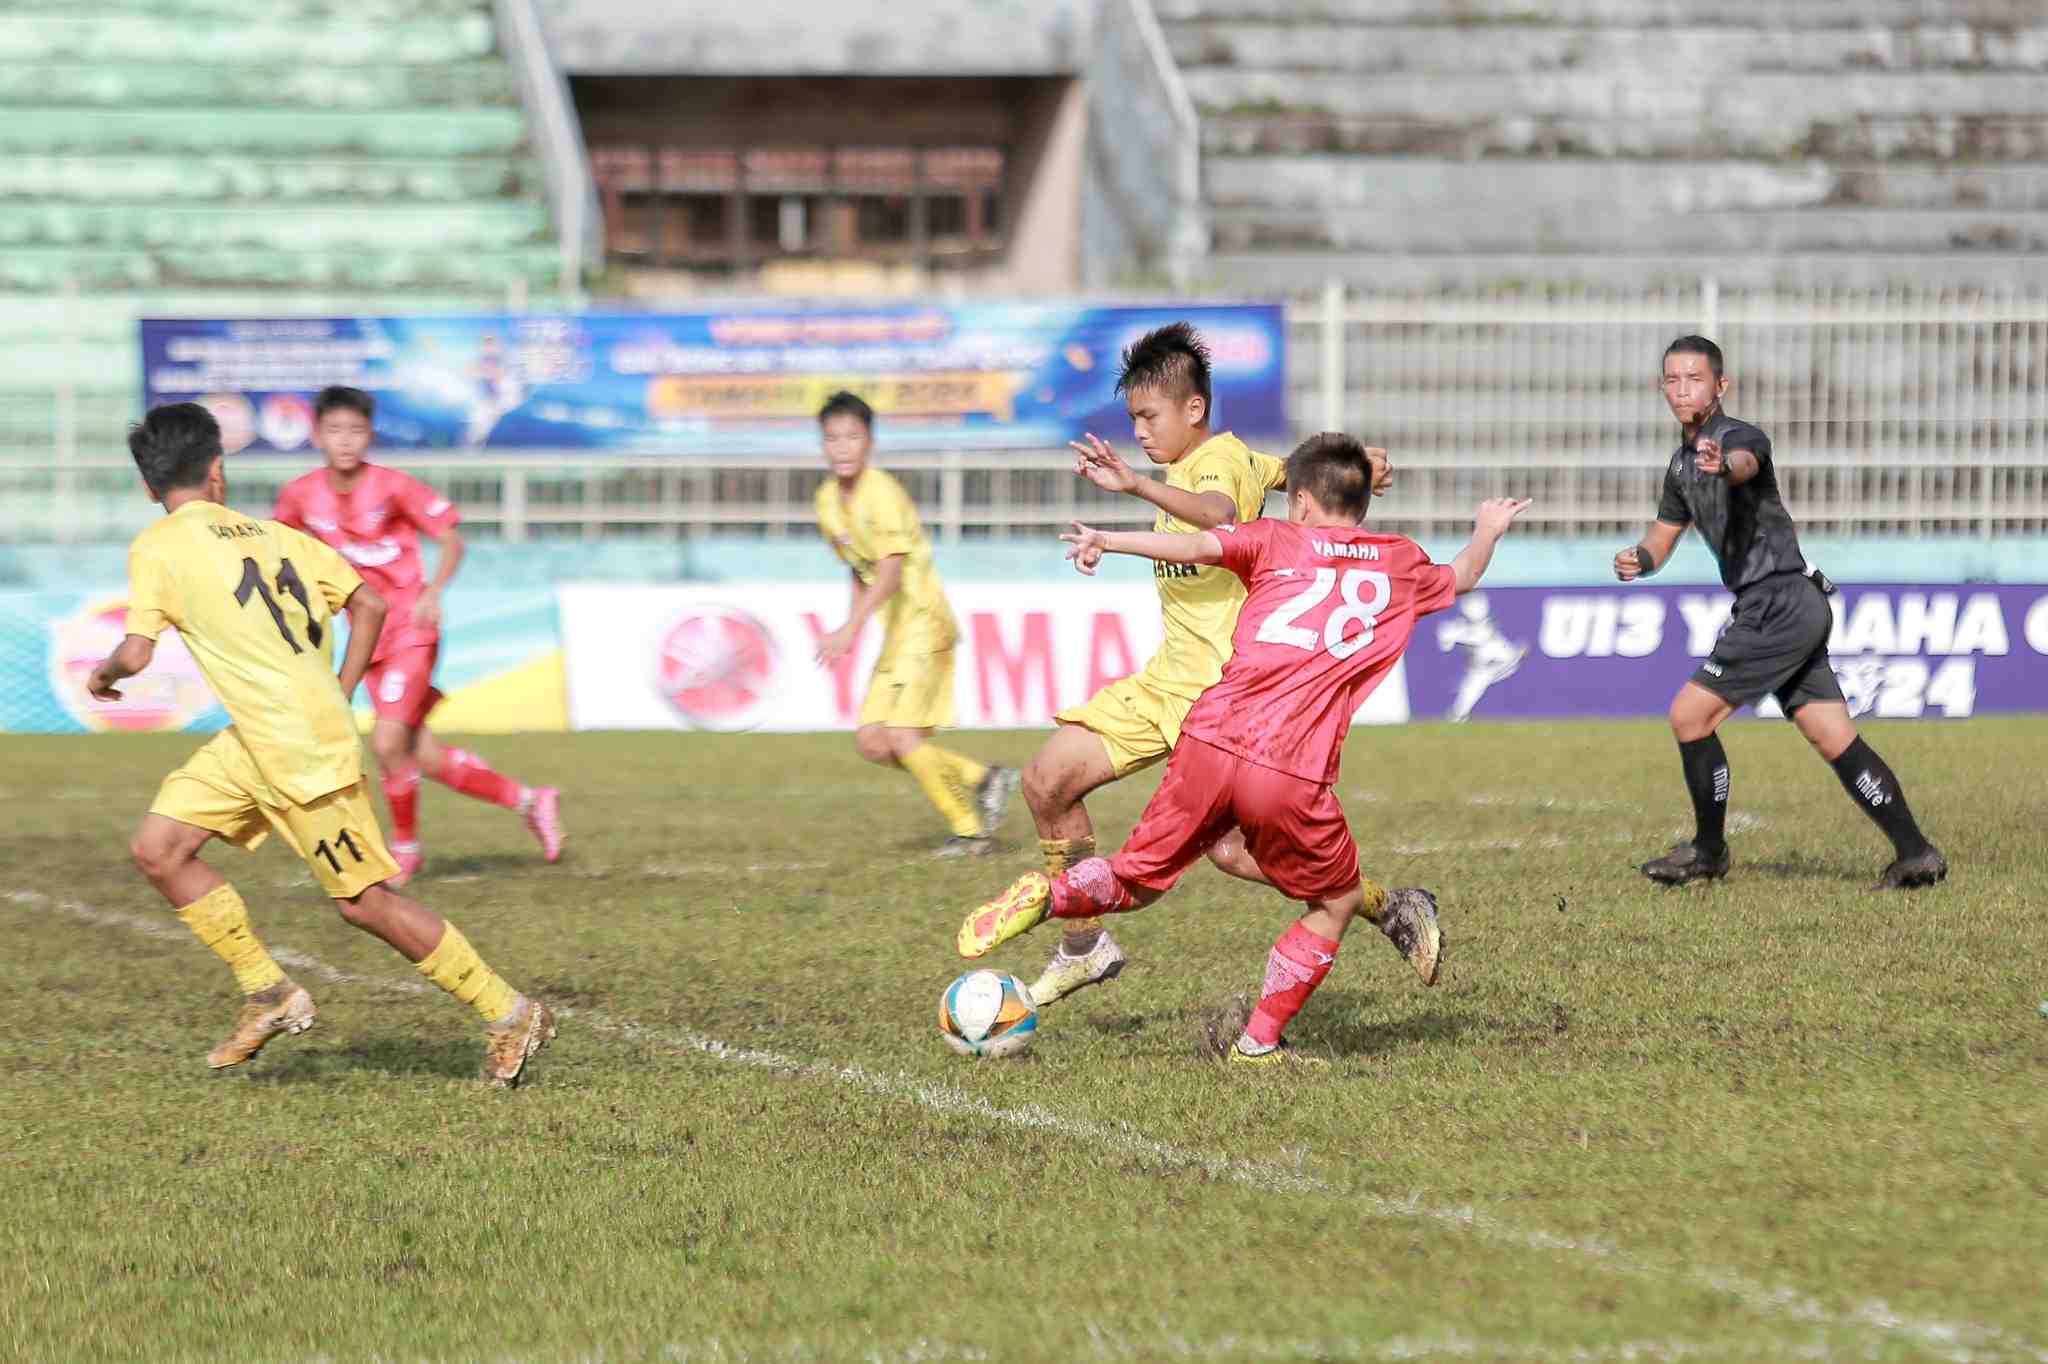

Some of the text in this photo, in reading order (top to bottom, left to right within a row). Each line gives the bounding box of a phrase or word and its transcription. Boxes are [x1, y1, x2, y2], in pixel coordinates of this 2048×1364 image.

[1312, 539, 1379, 561] YAMAHA
[233, 556, 324, 655] 11
[1255, 566, 1392, 660] 28
[1541, 594, 1666, 658] U13
[1677, 593, 2009, 656] YAHA
[801, 611, 1138, 716] YMA
[1713, 767, 1729, 802] mitre
[1856, 769, 1884, 807] mitre
[315, 827, 364, 875] 11
